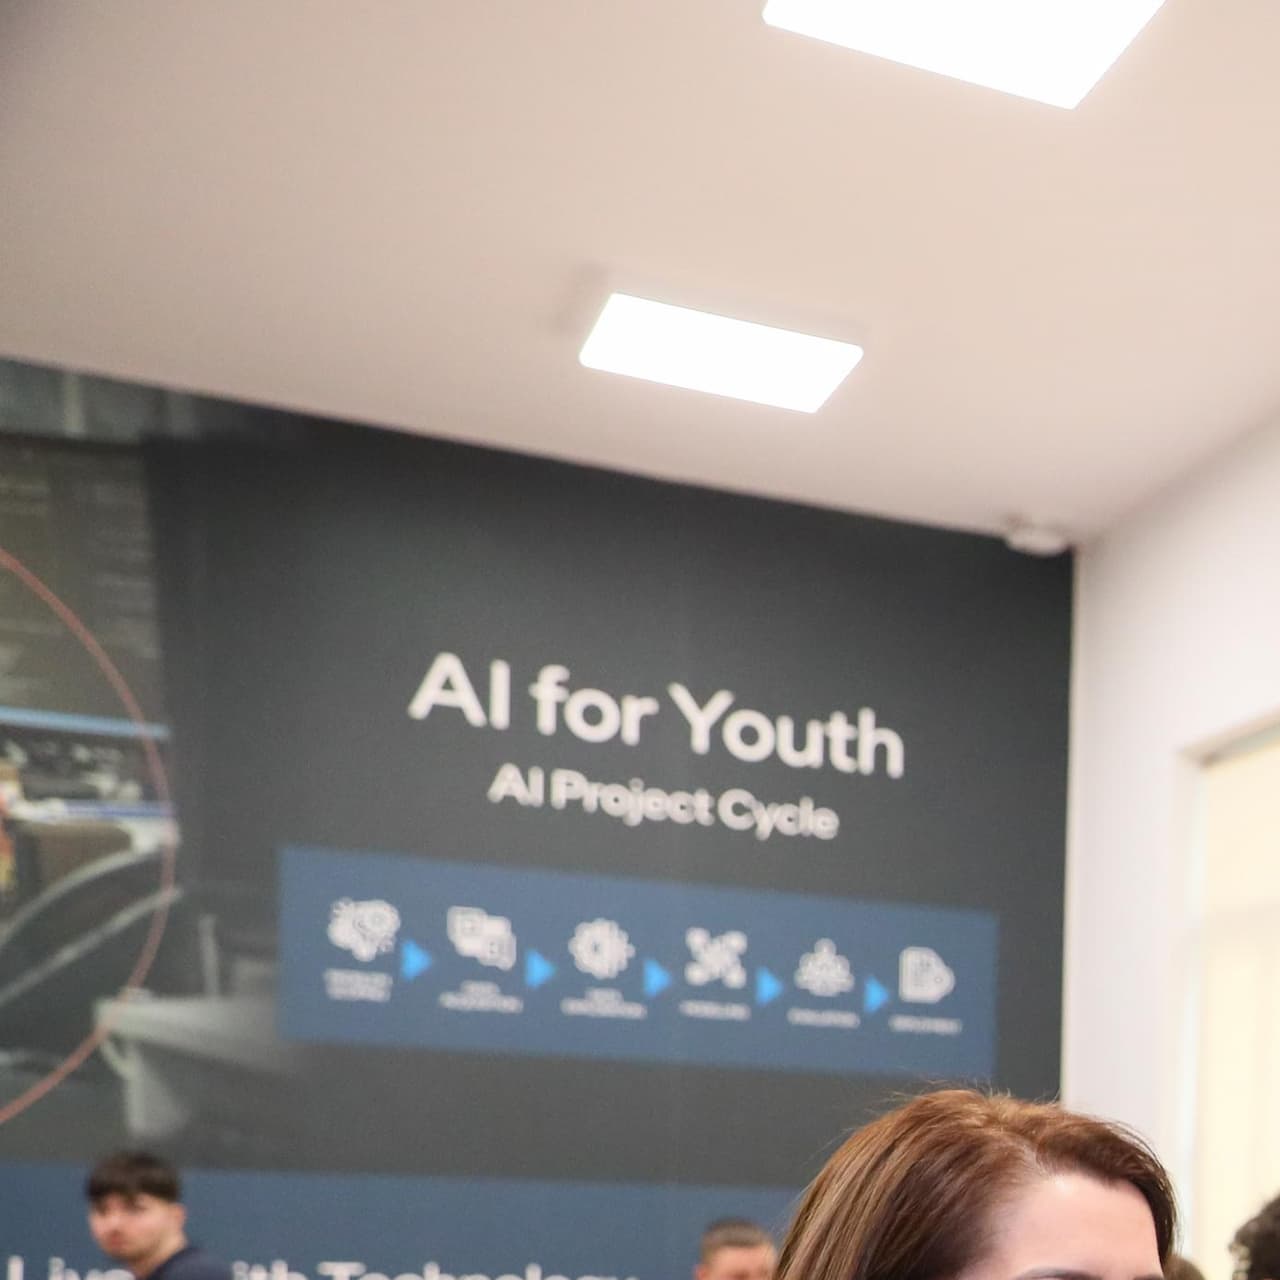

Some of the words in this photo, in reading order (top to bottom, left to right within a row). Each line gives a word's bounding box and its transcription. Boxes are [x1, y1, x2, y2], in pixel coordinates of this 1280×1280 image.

[408, 652, 511, 731] AI
[529, 664, 660, 747] for
[666, 682, 905, 780] Youth
[488, 762, 545, 808] AI
[550, 769, 714, 826] Project
[718, 786, 840, 840] Cycle
